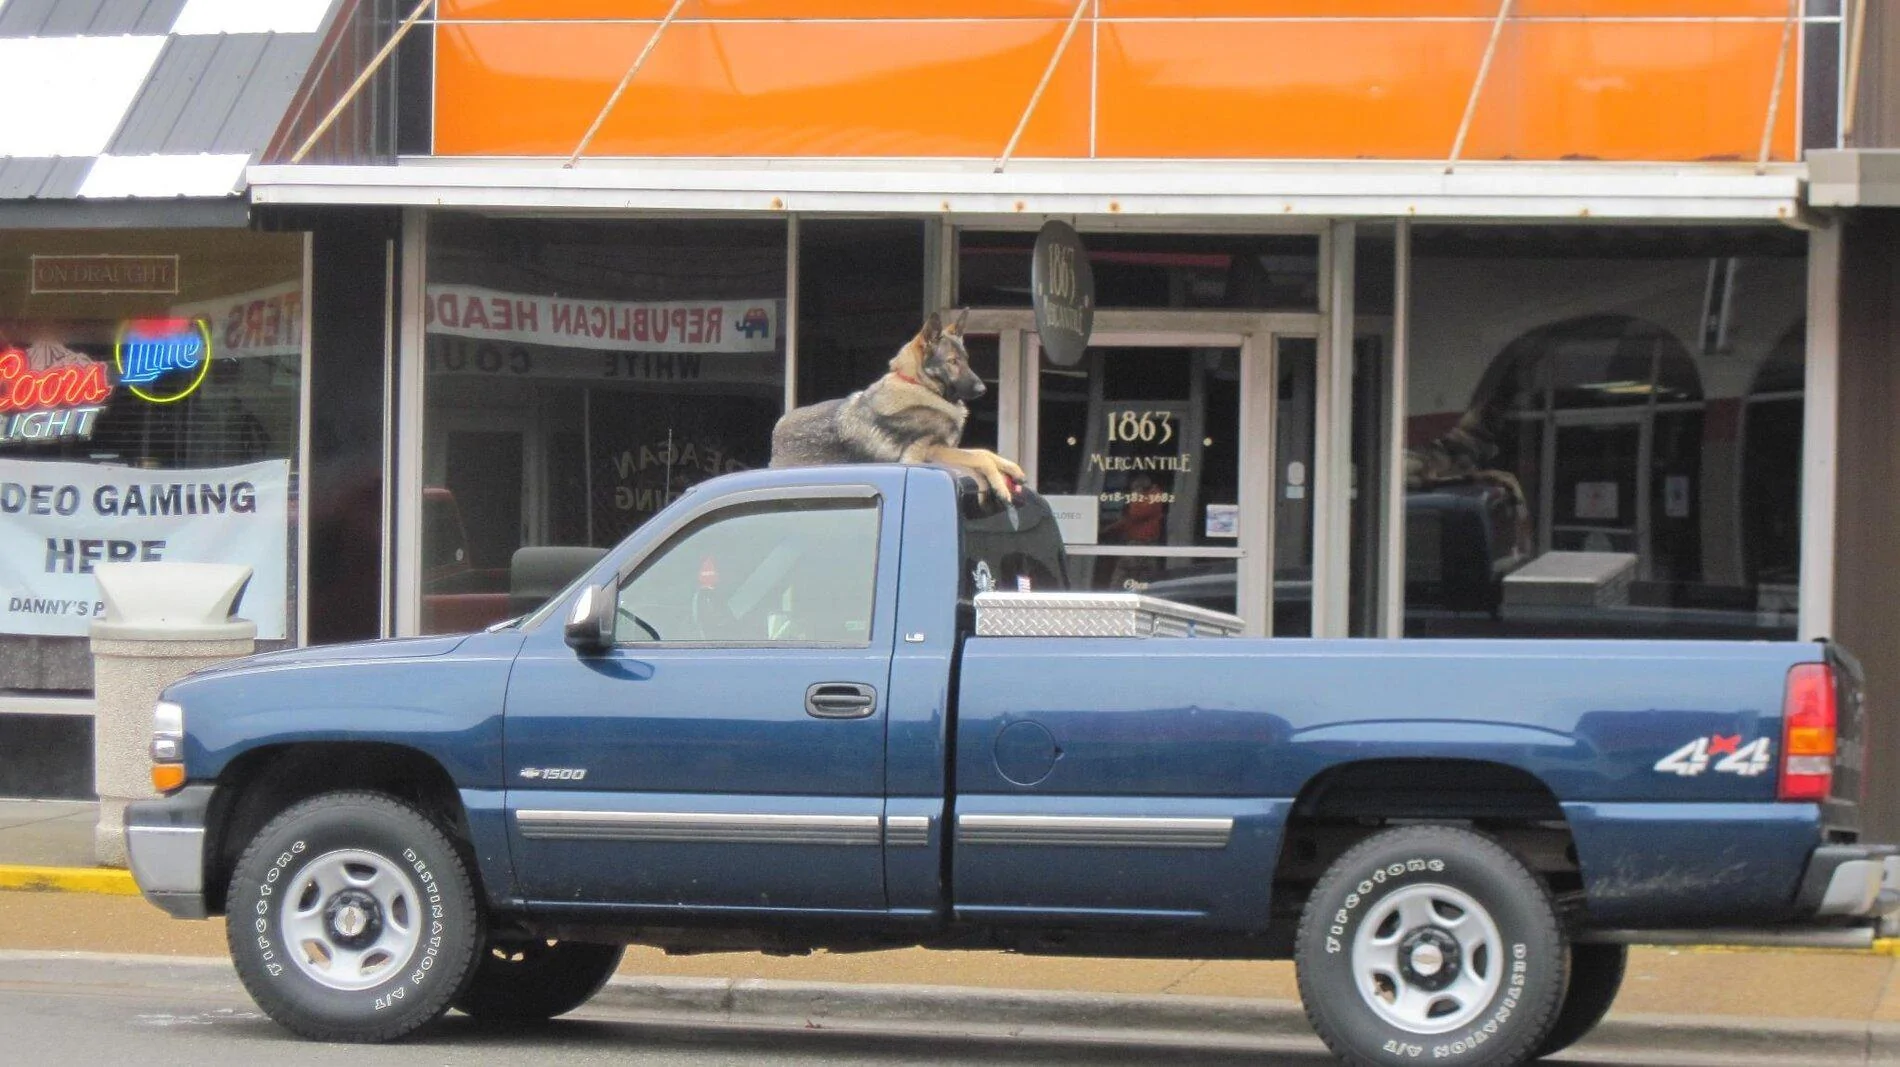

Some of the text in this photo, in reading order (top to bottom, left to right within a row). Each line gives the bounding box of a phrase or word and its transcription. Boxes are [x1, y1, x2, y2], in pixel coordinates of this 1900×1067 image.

[39, 264, 67, 283] ON
[0, 405, 104, 440] IGHT
[1108, 410, 1172, 445] 1863
[1087, 452, 1192, 473] MERCANTILE
[92, 481, 257, 517] GAMING
[8, 597, 89, 617] DANNY'S
[541, 766, 587, 780] 1500
[375, 848, 444, 1011] DESTINATION A/T
[1383, 942, 1528, 1059] DESTINATION A/T
